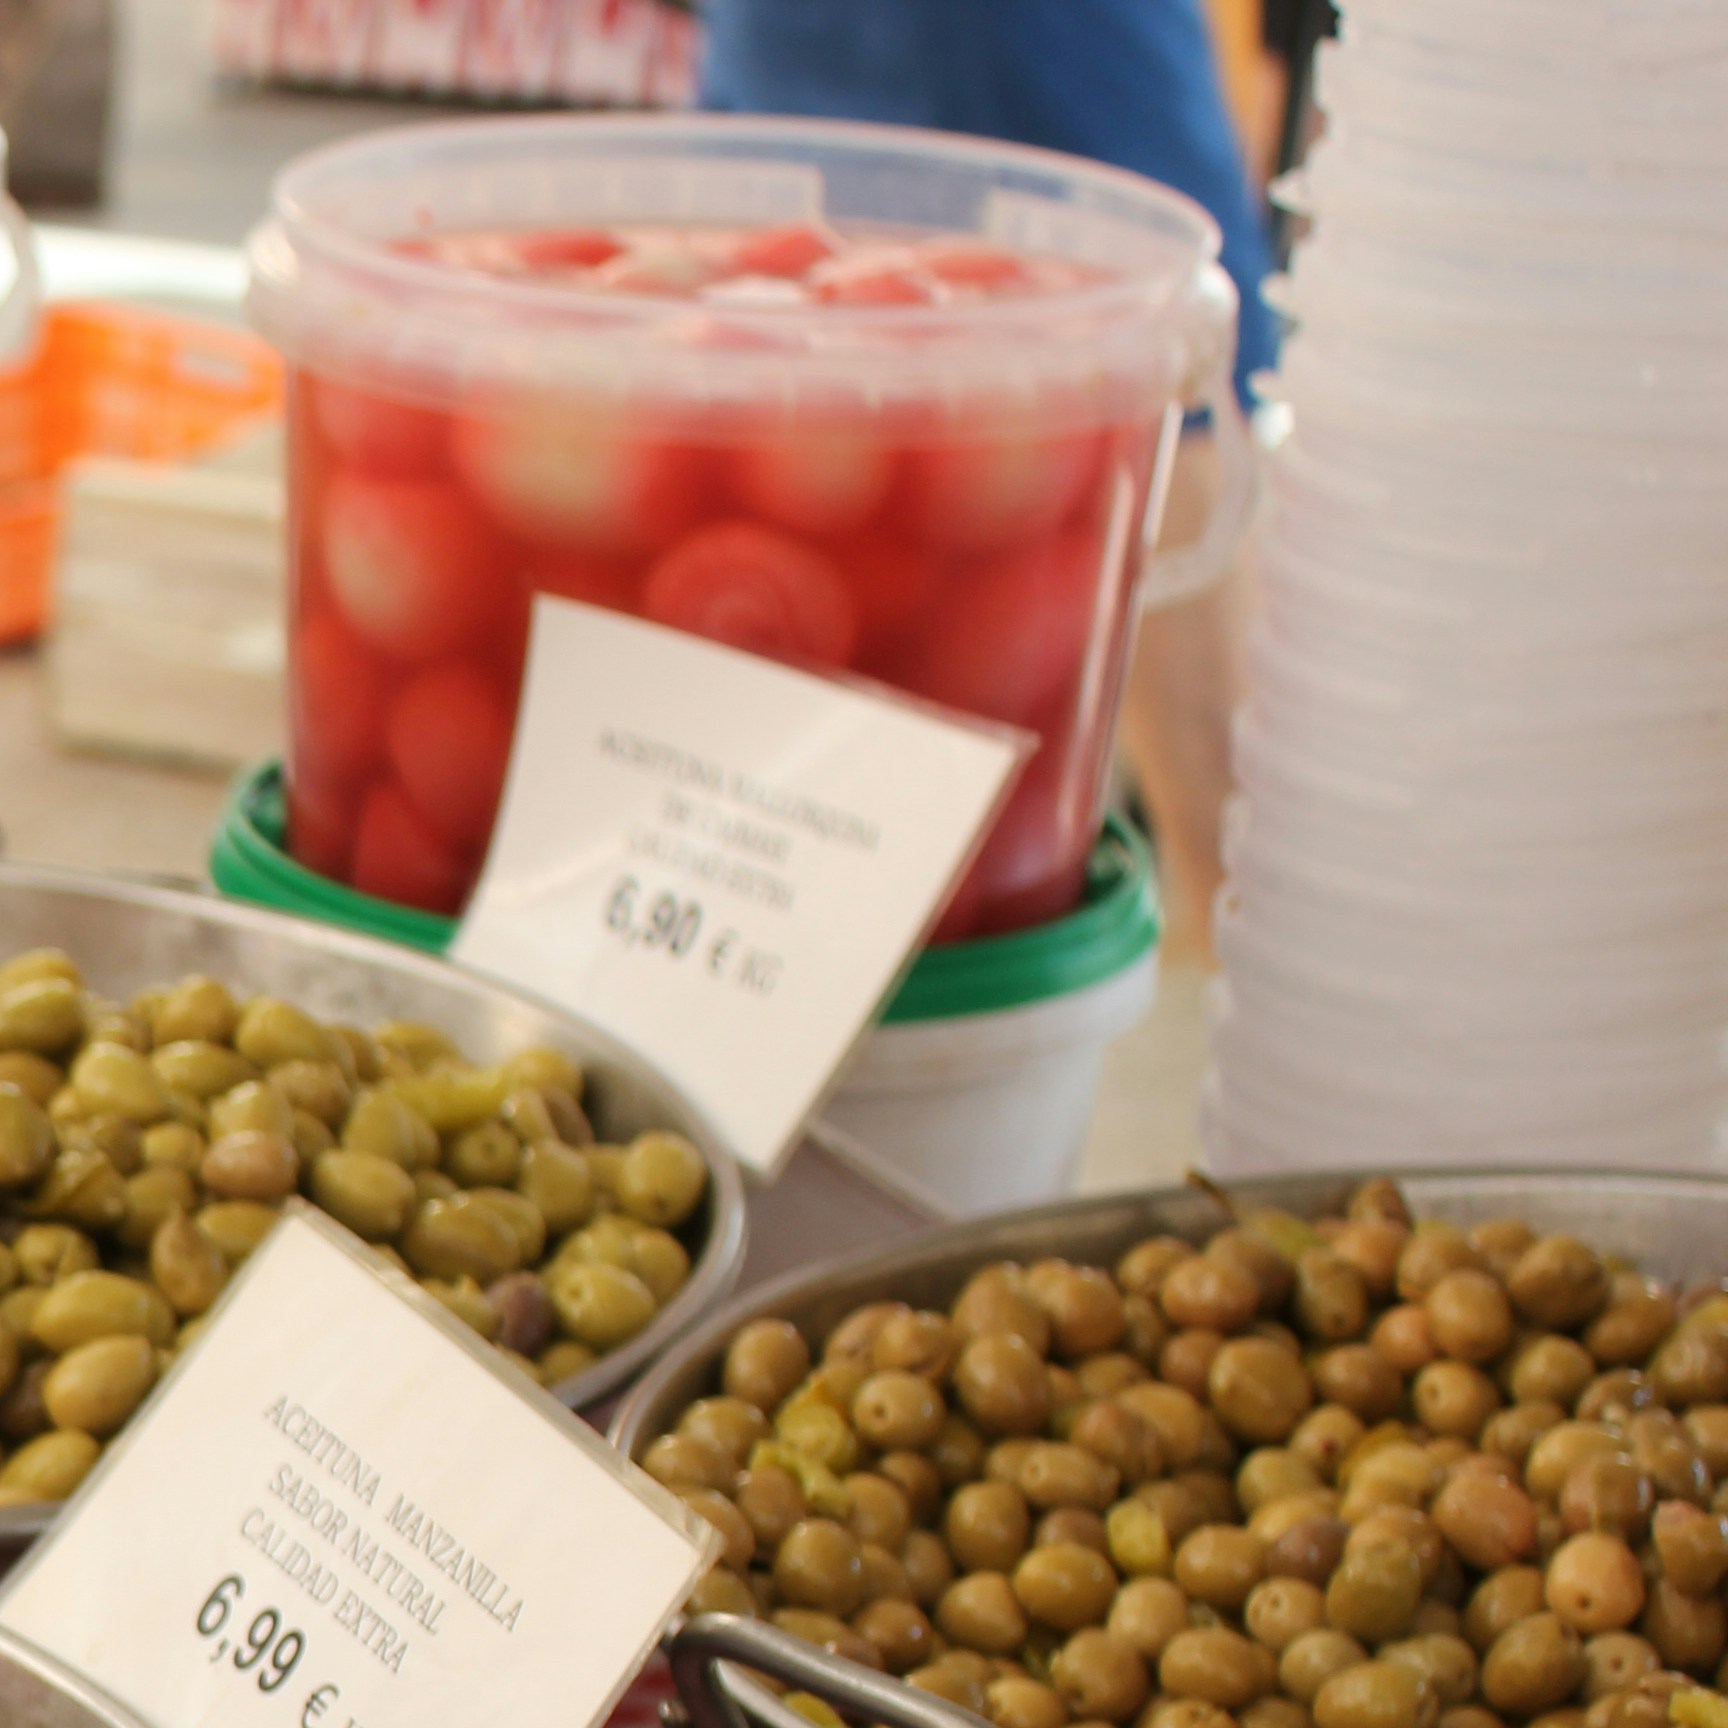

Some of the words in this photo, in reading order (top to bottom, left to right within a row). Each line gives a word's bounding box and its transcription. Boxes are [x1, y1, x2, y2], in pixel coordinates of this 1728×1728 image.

[605, 874, 703, 960] 6,90
[241, 1506, 339, 1606] CALIDAD
[333, 1588, 410, 1675] EXTRA
[263, 1395, 382, 1507] ACEITUNA
[384, 1493, 525, 1633] MANZANILLA
[268, 1462, 348, 1545] SABOR
[342, 1526, 448, 1636] NATURAL
[196, 1573, 308, 1694] 6,99
